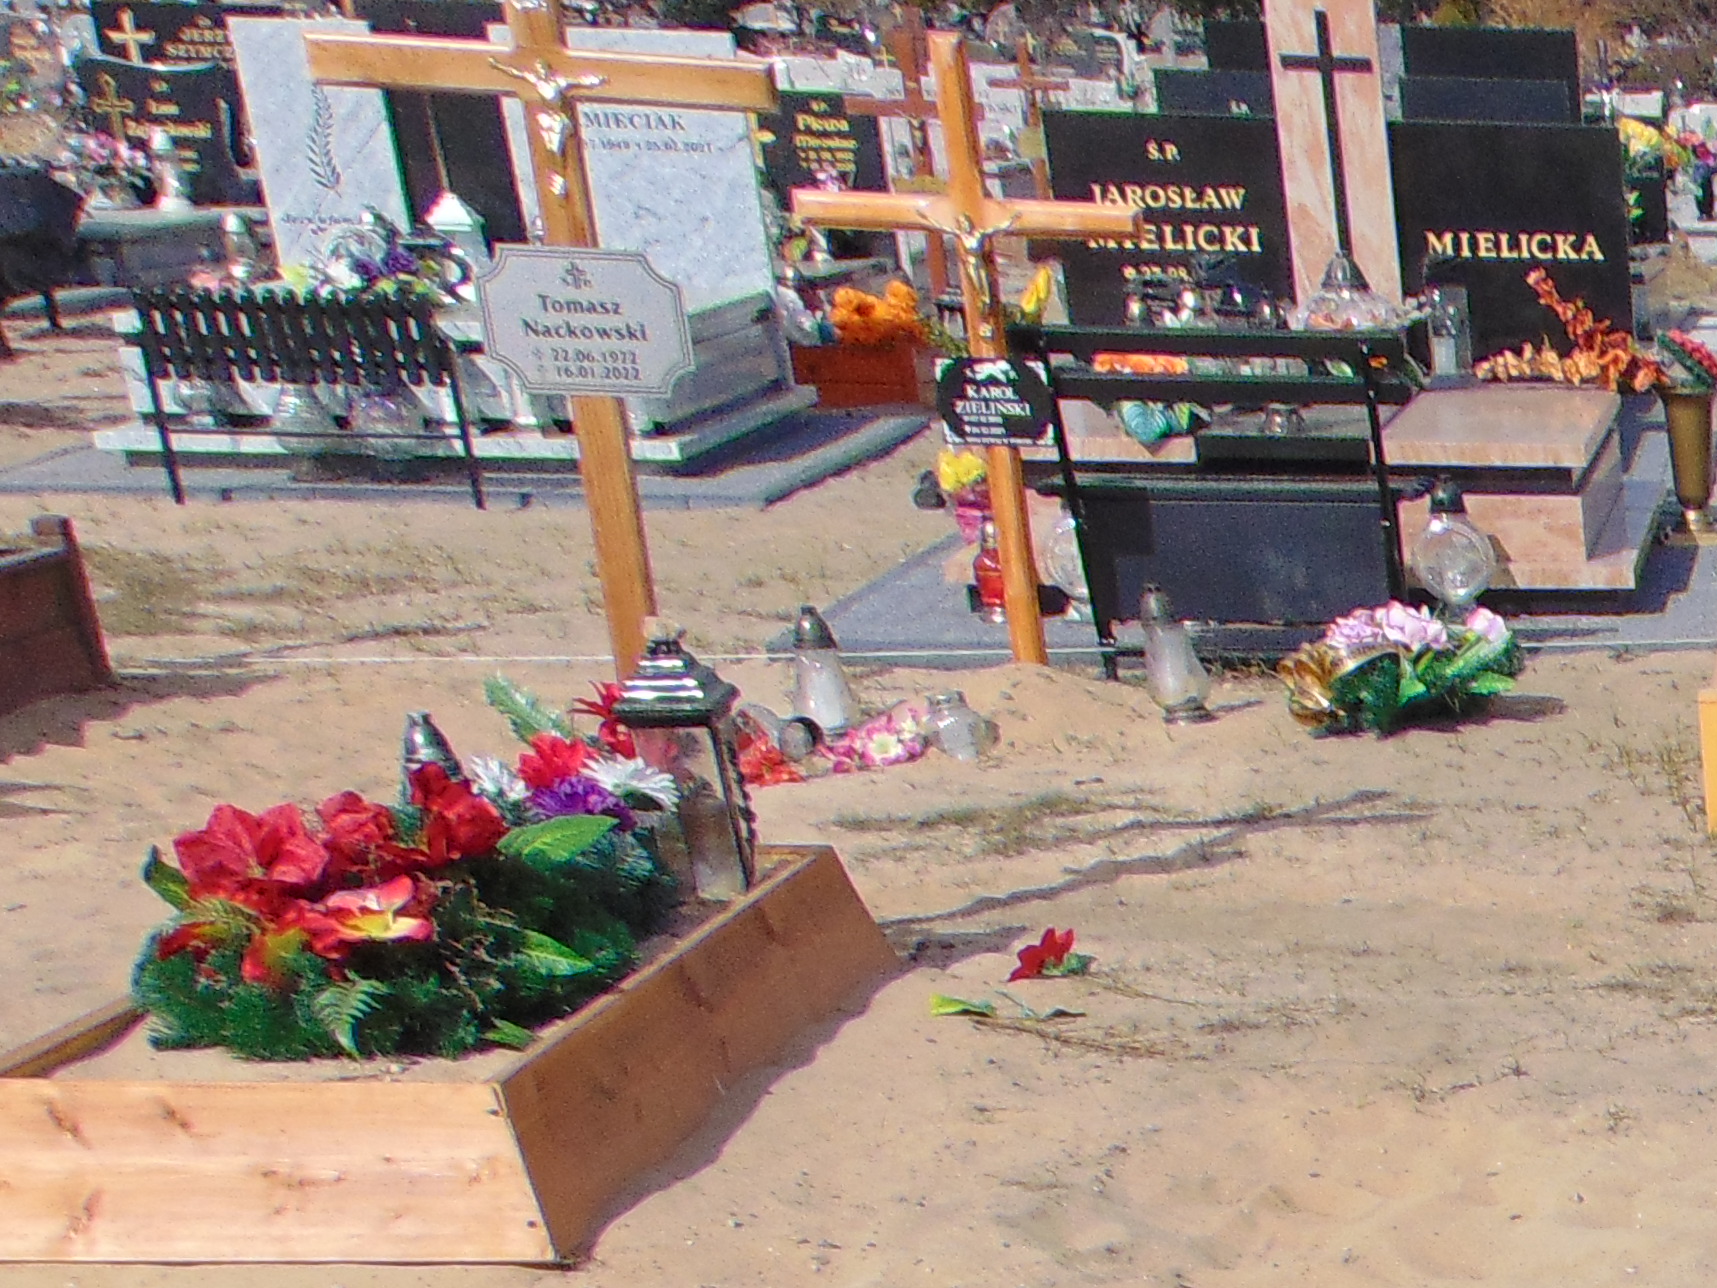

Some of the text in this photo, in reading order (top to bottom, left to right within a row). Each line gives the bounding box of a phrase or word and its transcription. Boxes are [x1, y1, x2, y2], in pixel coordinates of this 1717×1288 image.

[1090, 182, 1247, 210] JAROSŁAW
[1086, 223, 1263, 252] ELICKI
[1424, 230, 1606, 261] MIELICKA
[537, 293, 623, 316] Tomasz
[521, 317, 648, 342] Nackowski
[964, 384, 1020, 399] KAROL
